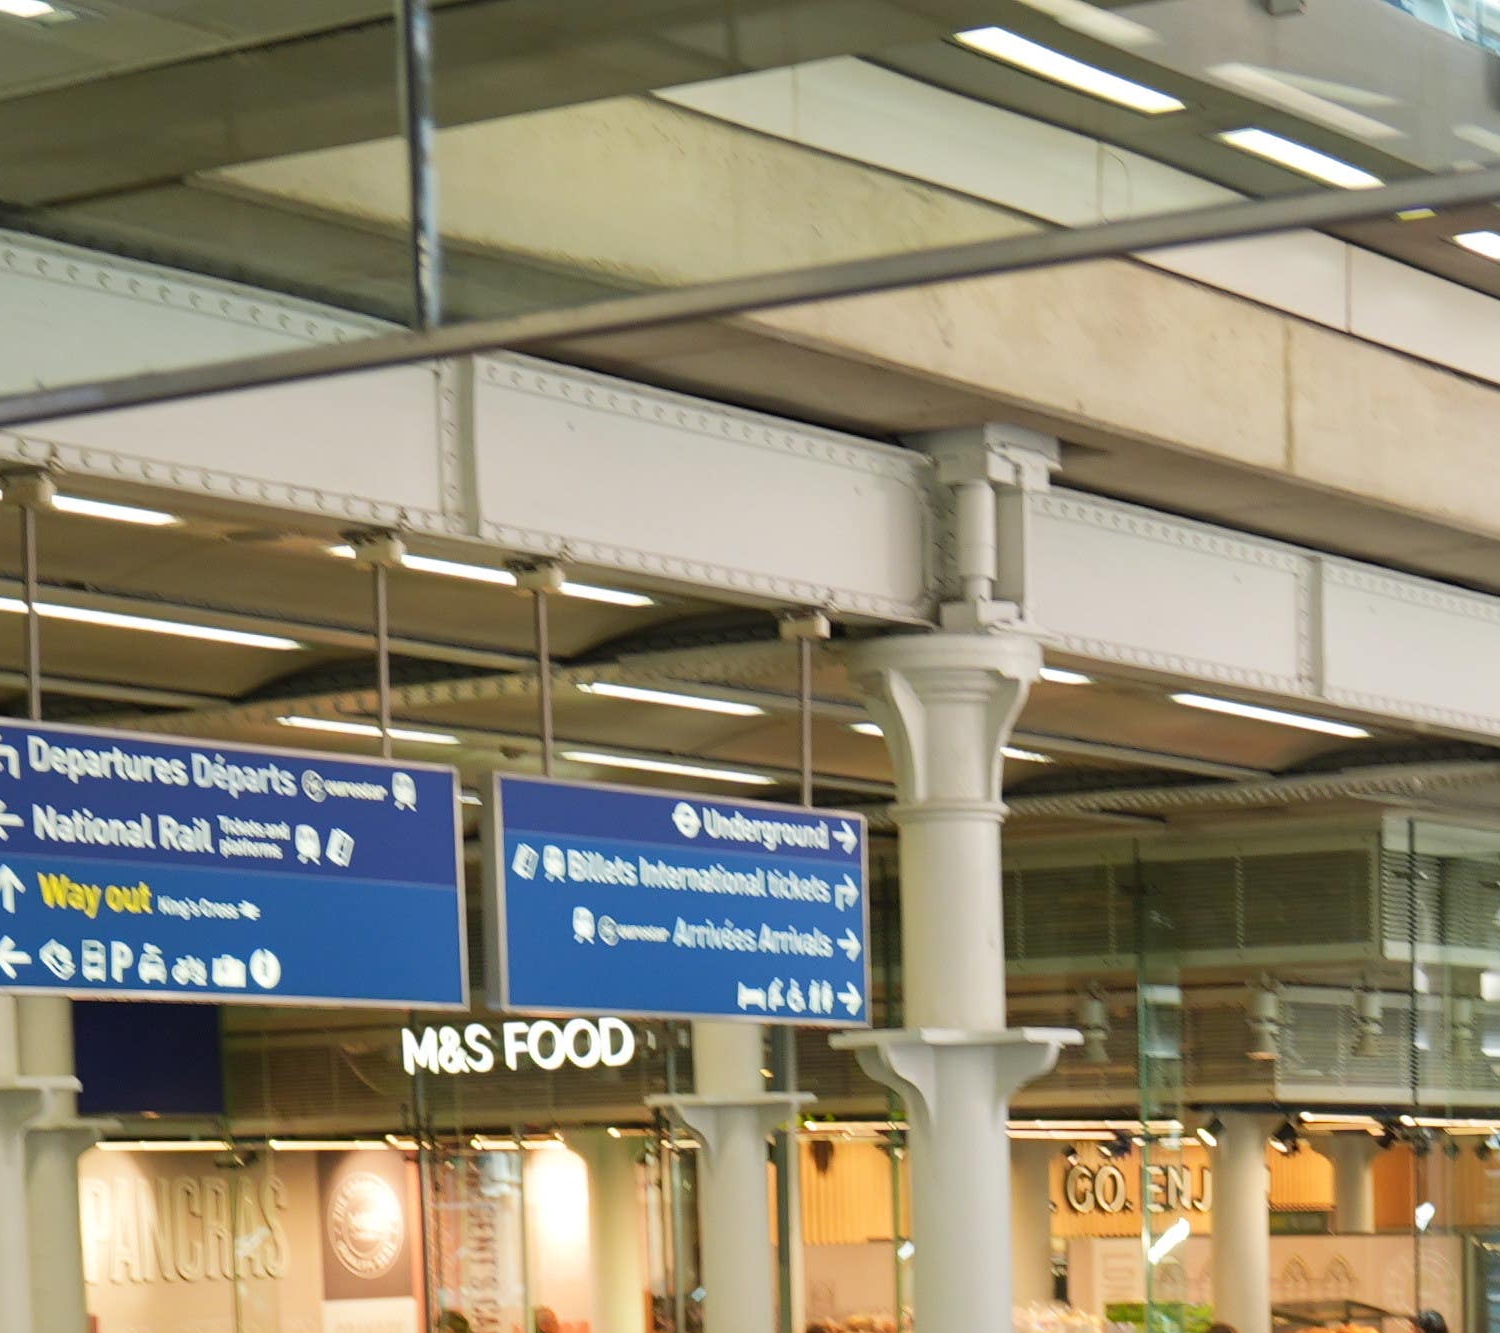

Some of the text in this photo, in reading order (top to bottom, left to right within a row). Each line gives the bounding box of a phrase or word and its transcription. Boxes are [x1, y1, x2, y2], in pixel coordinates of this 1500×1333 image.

[27, 736, 189, 784] Departures
[192, 753, 297, 798] Départs
[32, 804, 215, 854] National Rail
[218, 815, 291, 841] Tickets and
[219, 838, 284, 861] platforms
[701, 806, 830, 851] Underground
[37, 872, 102, 919] Way
[105, 881, 154, 915] out
[567, 849, 831, 903] Billets International tickets
[673, 916, 758, 952] Arrivées
[758, 923, 834, 958] Arrivals
[402, 1017, 635, 1076] M&S FOOD
[80, 1171, 290, 1285] PANCRAS
